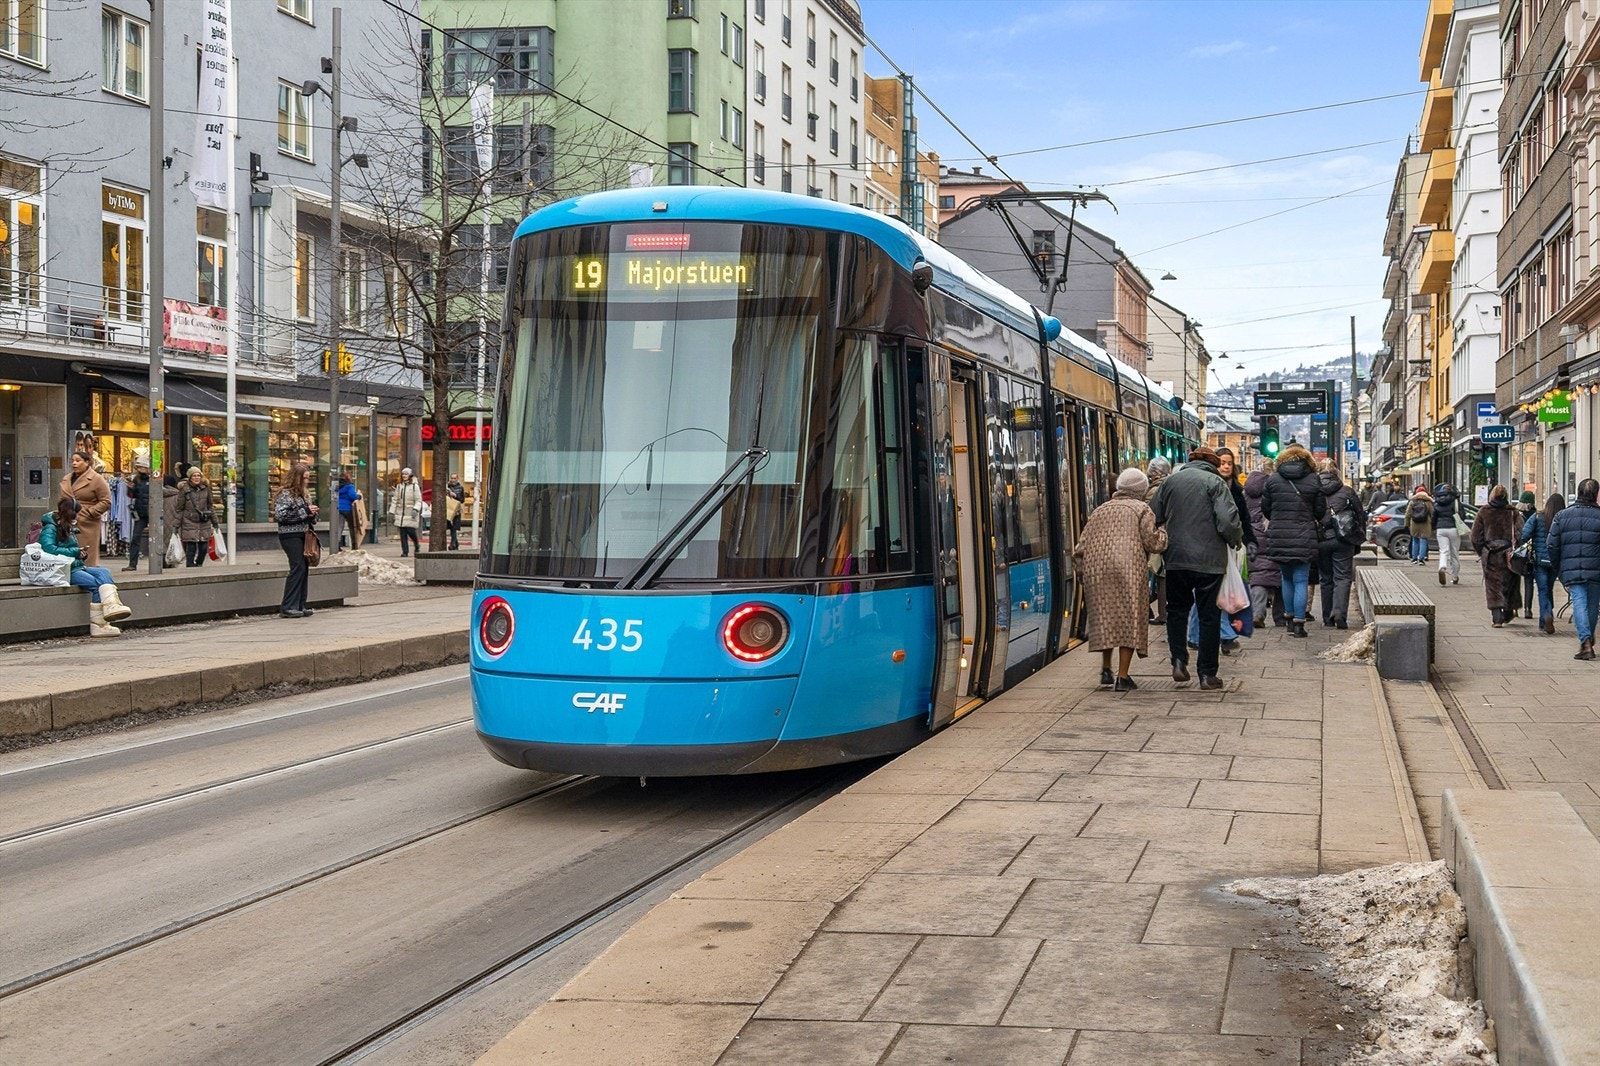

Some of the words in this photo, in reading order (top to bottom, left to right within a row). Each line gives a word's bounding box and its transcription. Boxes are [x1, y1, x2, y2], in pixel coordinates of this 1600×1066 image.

[574, 261, 602, 288] 19
[628, 260, 746, 290] Majorstuen
[1546, 406, 1569, 414] Musti
[1484, 428, 1512, 439] norli
[1347, 440, 1355, 451] P
[572, 618, 643, 652] 435
[572, 692, 627, 714] CAF
